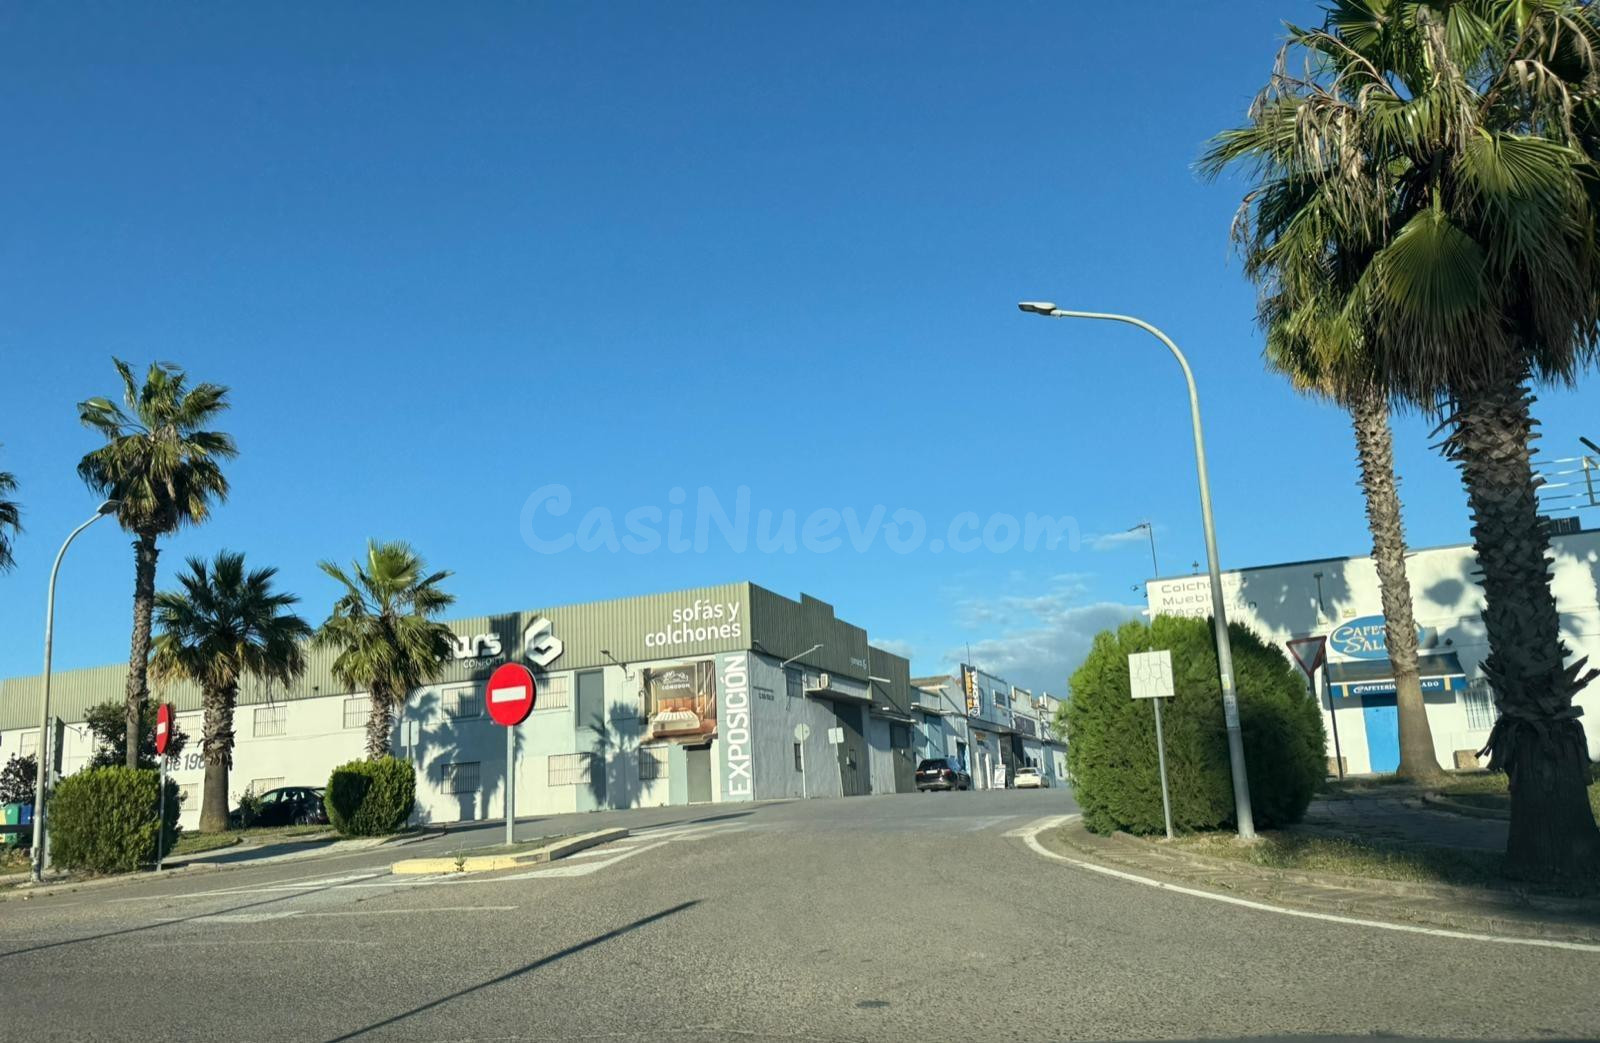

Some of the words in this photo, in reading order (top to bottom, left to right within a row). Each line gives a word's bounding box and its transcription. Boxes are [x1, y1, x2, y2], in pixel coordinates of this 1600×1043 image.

[673, 599, 723, 623] sofás
[728, 601, 739, 622] y
[645, 622, 741, 647] colchones
[720, 655, 751, 796] EXPOSICIÓN
